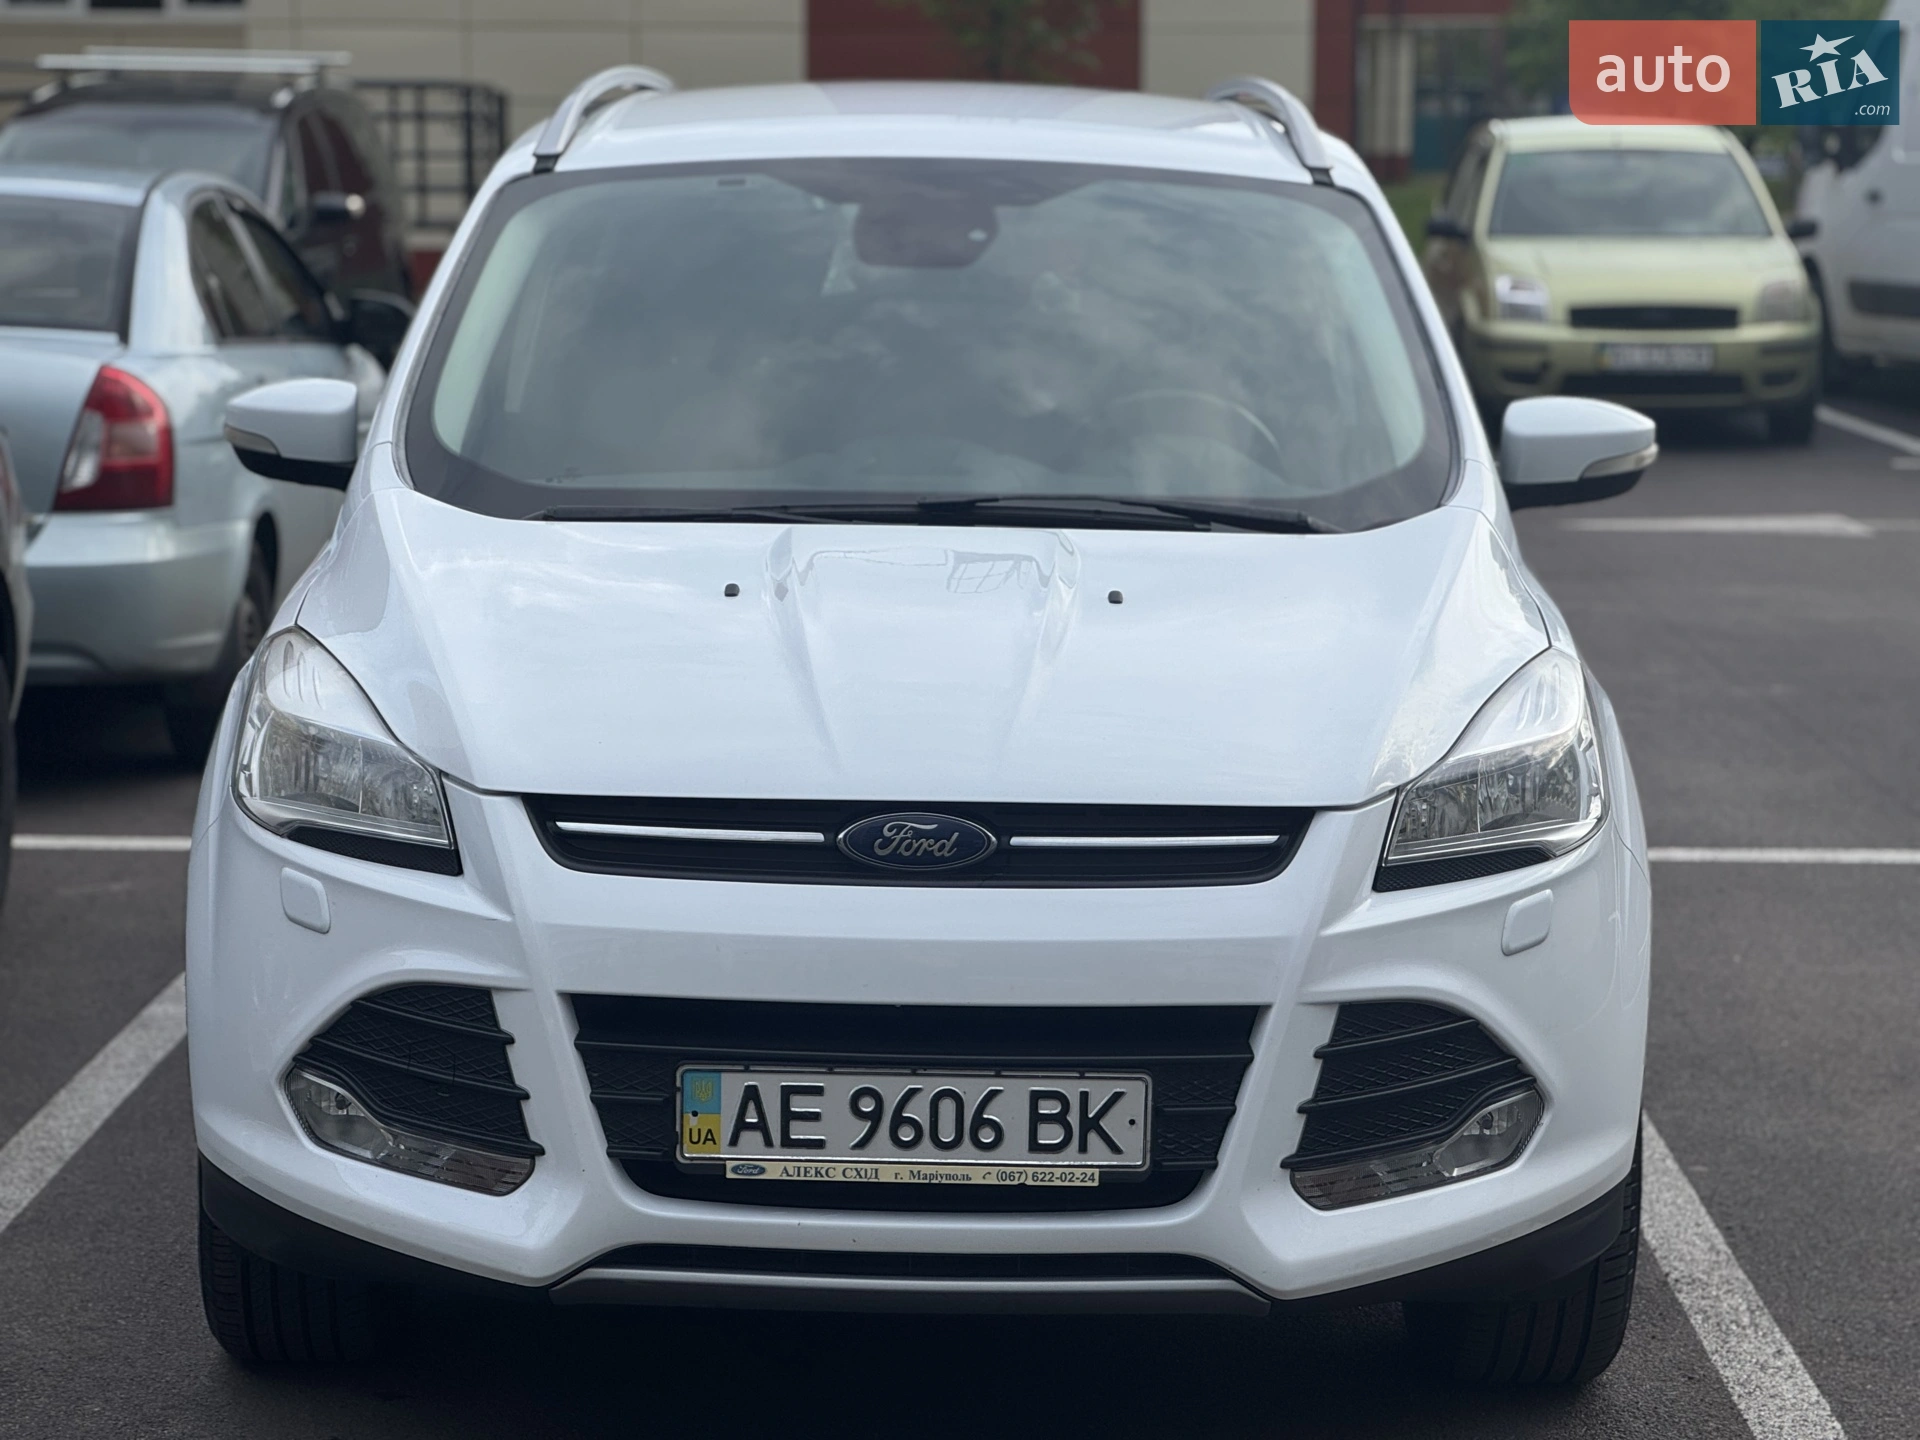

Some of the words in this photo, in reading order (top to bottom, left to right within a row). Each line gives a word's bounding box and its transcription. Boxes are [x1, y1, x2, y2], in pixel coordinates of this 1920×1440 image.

[873, 821, 960, 857] Ford
[727, 1081, 826, 1149] AE
[848, 1084, 1005, 1152] 9606
[1027, 1086, 1127, 1155] BK
[688, 1128, 717, 1145] UA
[736, 1164, 761, 1175] Ford
[779, 1165, 836, 1178] АЛЕКС
[842, 1167, 880, 1181] СХІД
[894, 1171, 904, 1180] г.
[908, 1169, 972, 1183] Маріуполь
[996, 1169, 1028, 1183] (067)
[1031, 1171, 1096, 1183] 622-02-24
